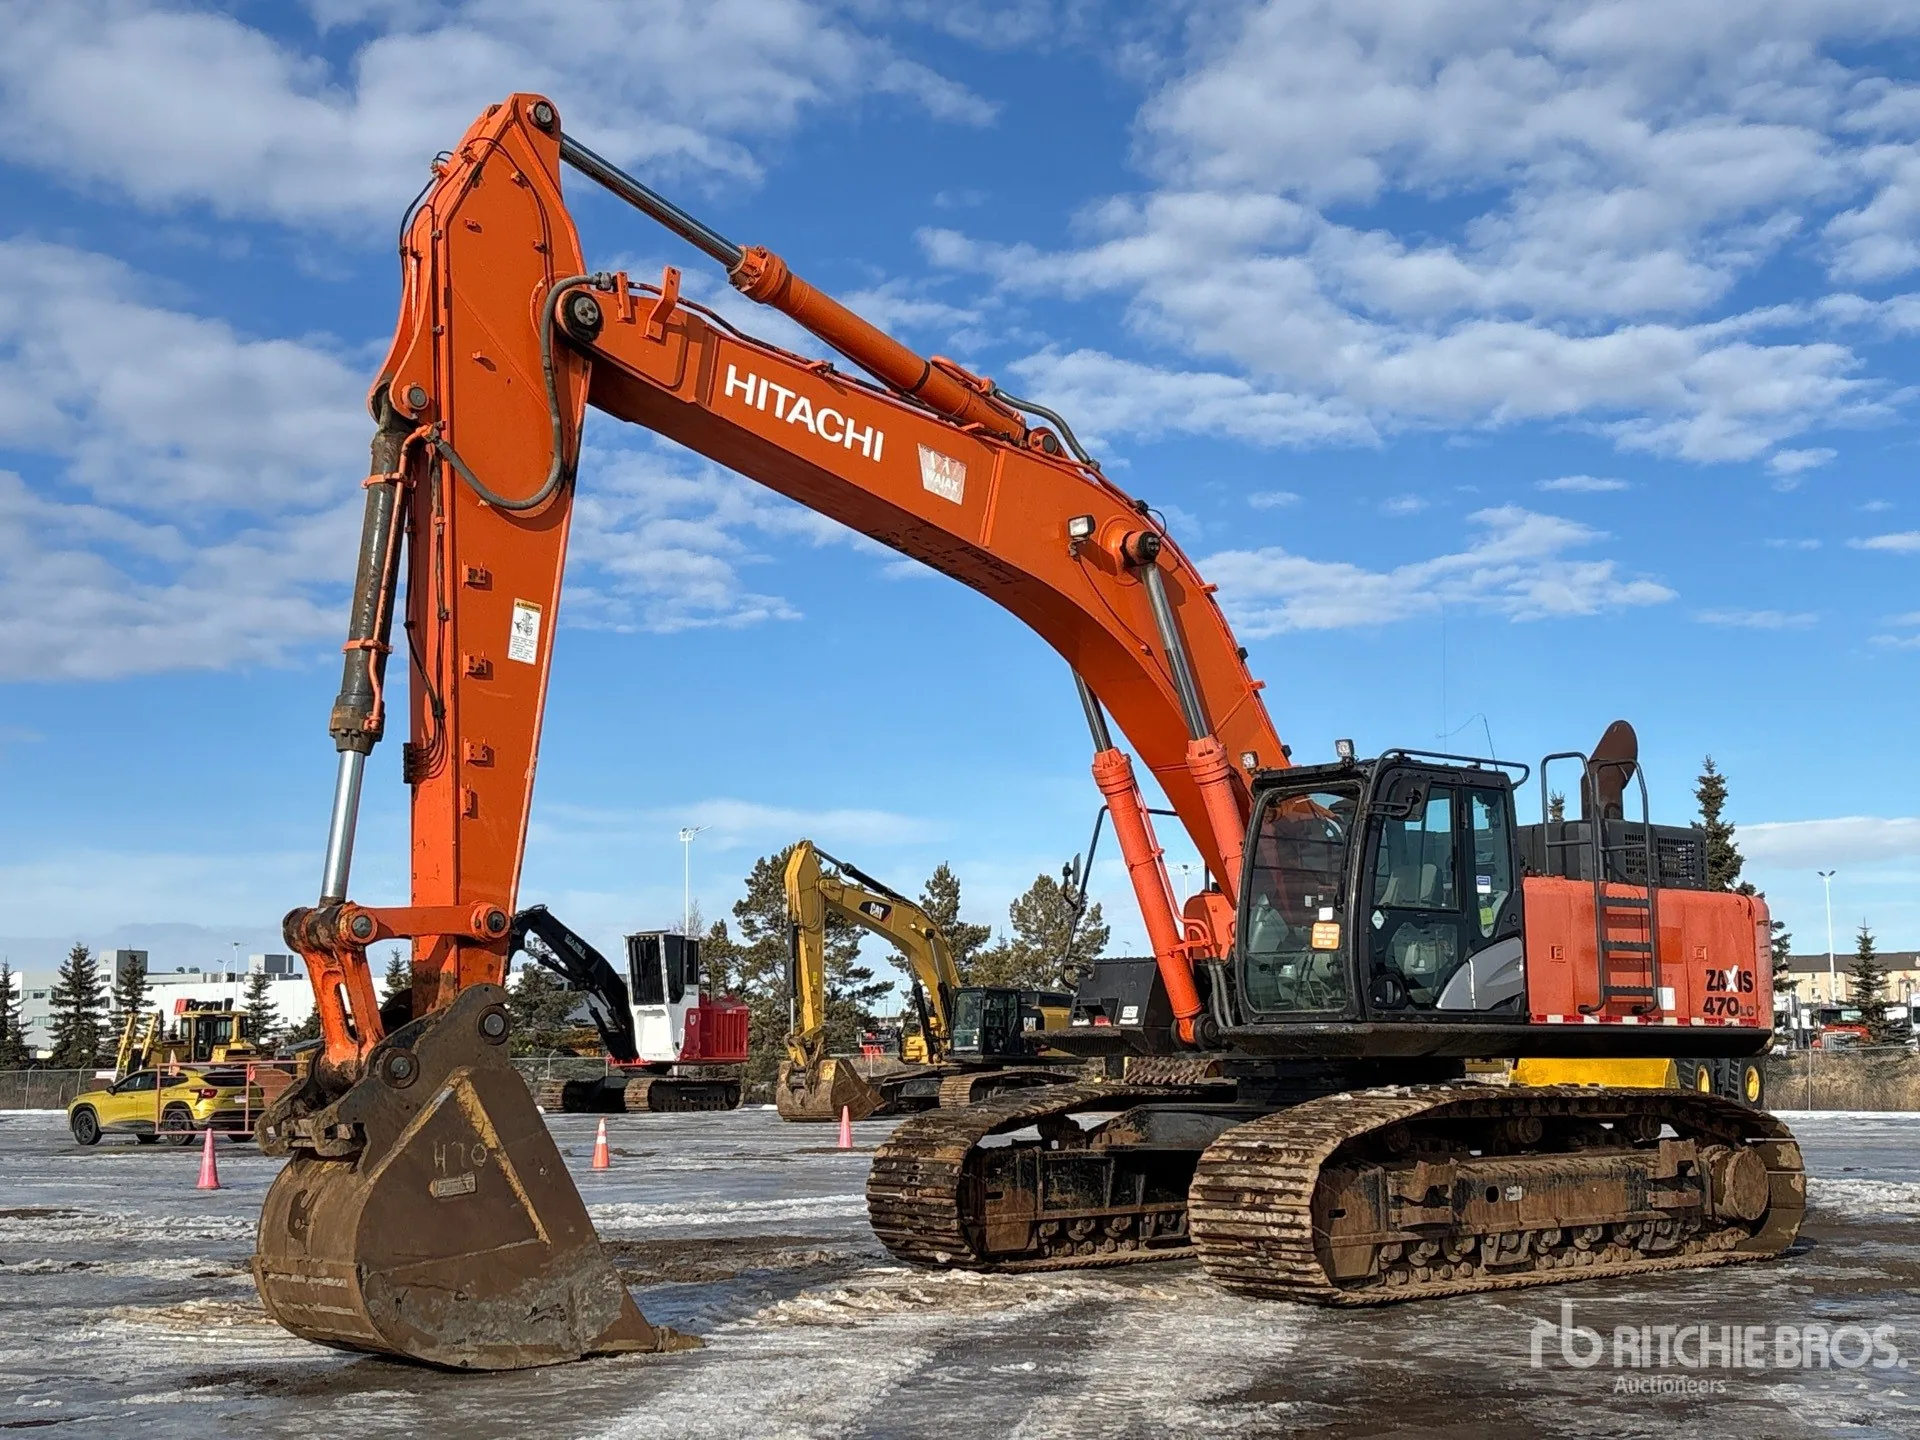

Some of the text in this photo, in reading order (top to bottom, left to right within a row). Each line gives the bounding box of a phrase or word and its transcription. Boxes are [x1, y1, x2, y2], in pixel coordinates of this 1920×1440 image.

[724, 364, 885, 462] HITACHI
[870, 902, 884, 920] CAT
[1705, 964, 1754, 993] ZAXIS
[1023, 1017, 1037, 1031] CAT
